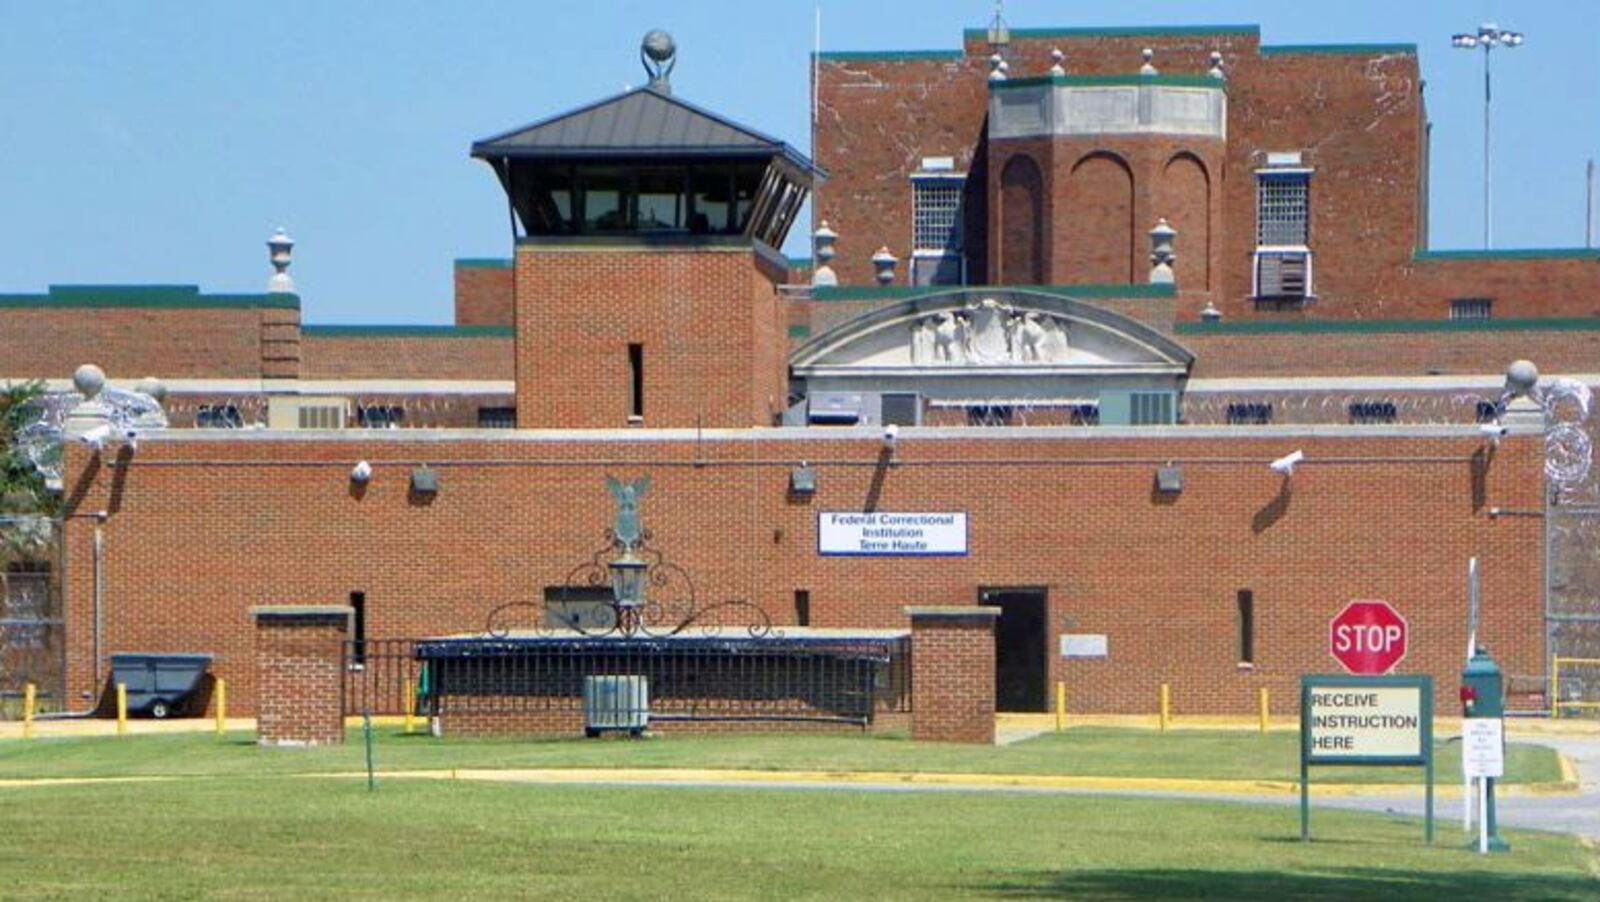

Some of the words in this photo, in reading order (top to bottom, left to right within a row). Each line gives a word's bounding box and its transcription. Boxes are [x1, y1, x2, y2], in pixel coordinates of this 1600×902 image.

[831, 514, 876, 524] Federal
[880, 514, 954, 524] Correctional
[862, 527, 924, 538] Institution
[860, 539, 888, 550] Terre
[892, 540, 927, 550] Haute
[1336, 625, 1401, 652] STOP
[1312, 693, 1378, 707] RECEIVE
[1312, 714, 1417, 728] INSTRUCTION
[1312, 736, 1354, 749] HERE
